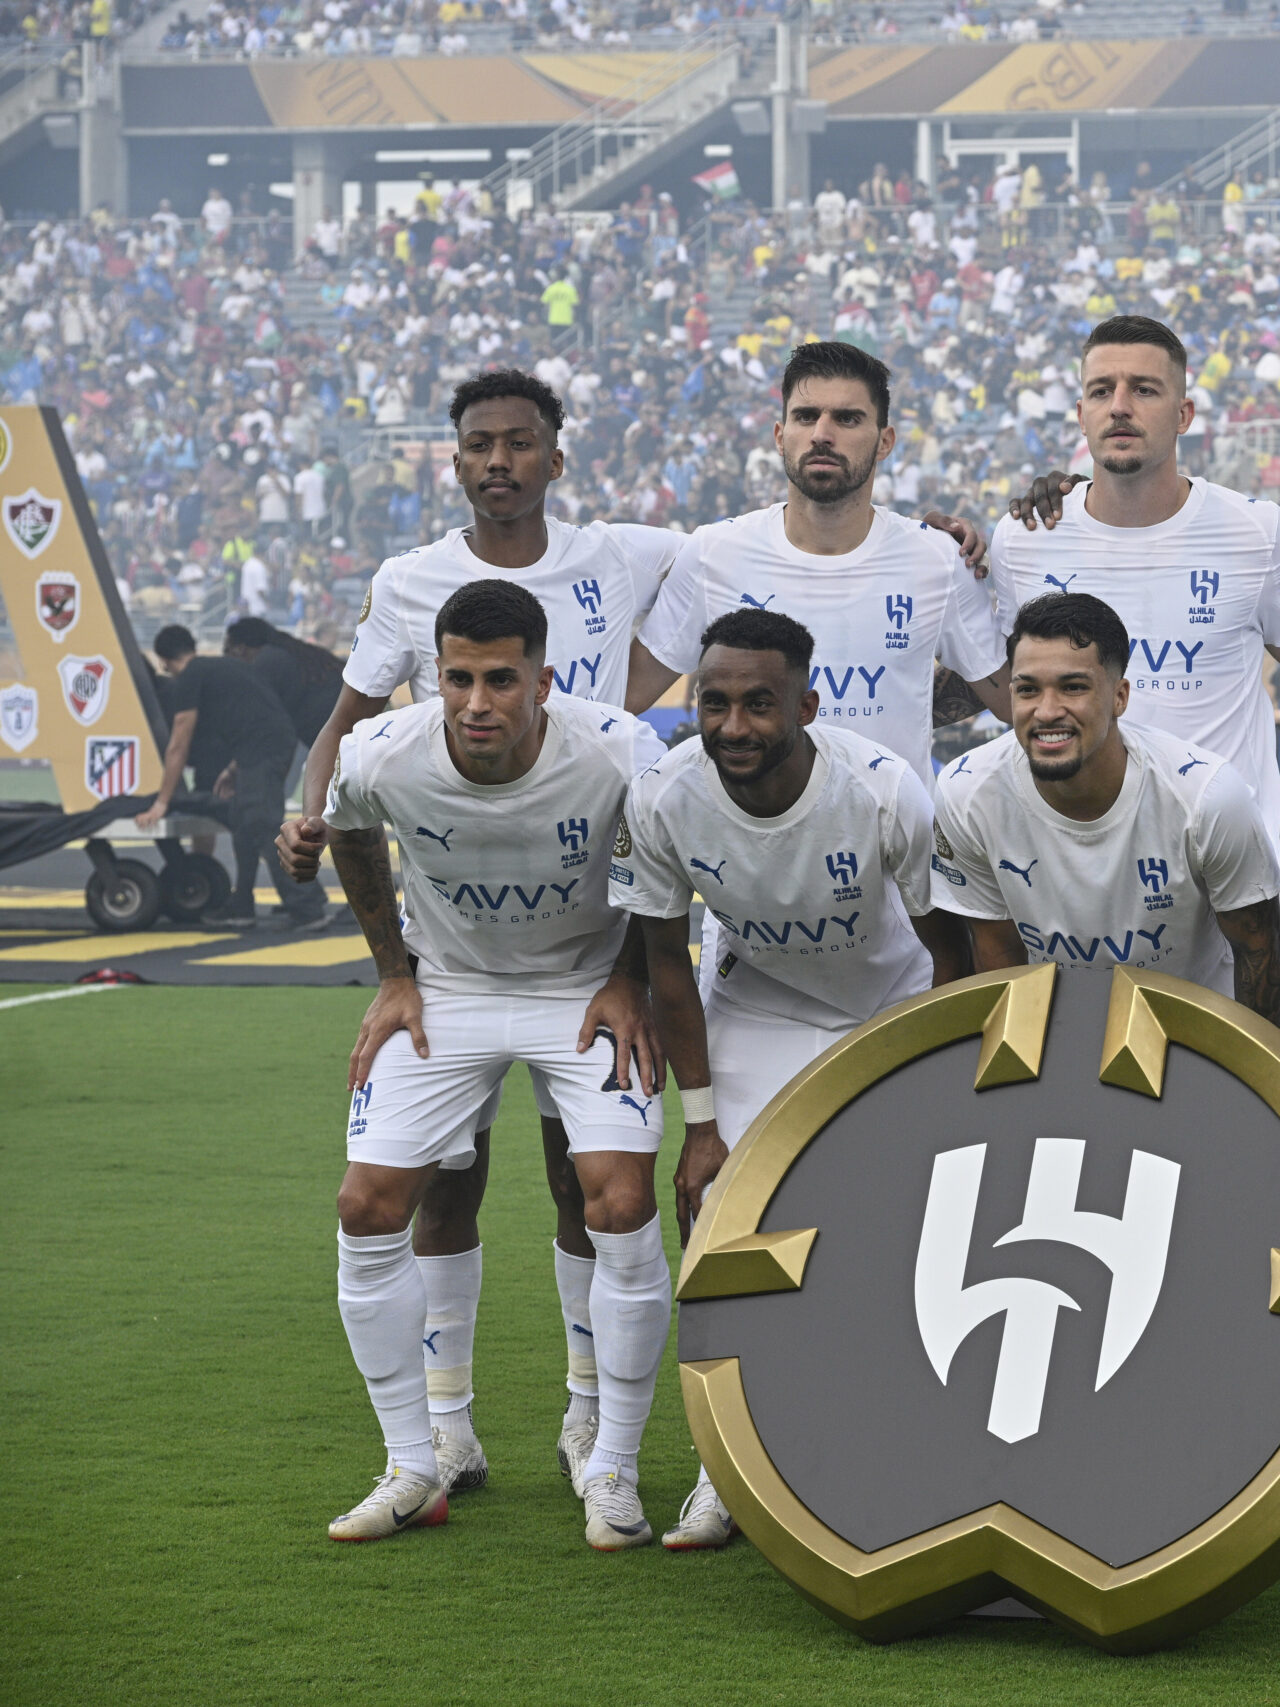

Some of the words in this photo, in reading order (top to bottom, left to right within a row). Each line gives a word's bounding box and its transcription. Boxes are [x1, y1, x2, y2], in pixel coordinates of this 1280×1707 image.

[1189, 607, 1216, 616] ALHILAL
[1136, 679, 1203, 691] GROUP
[818, 705, 884, 717] GROUP
[510, 902, 580, 923] GROUP
[713, 909, 860, 945] SAVVY
[799, 935, 868, 955] GROUP
[1018, 922, 1166, 962] SAVVY
